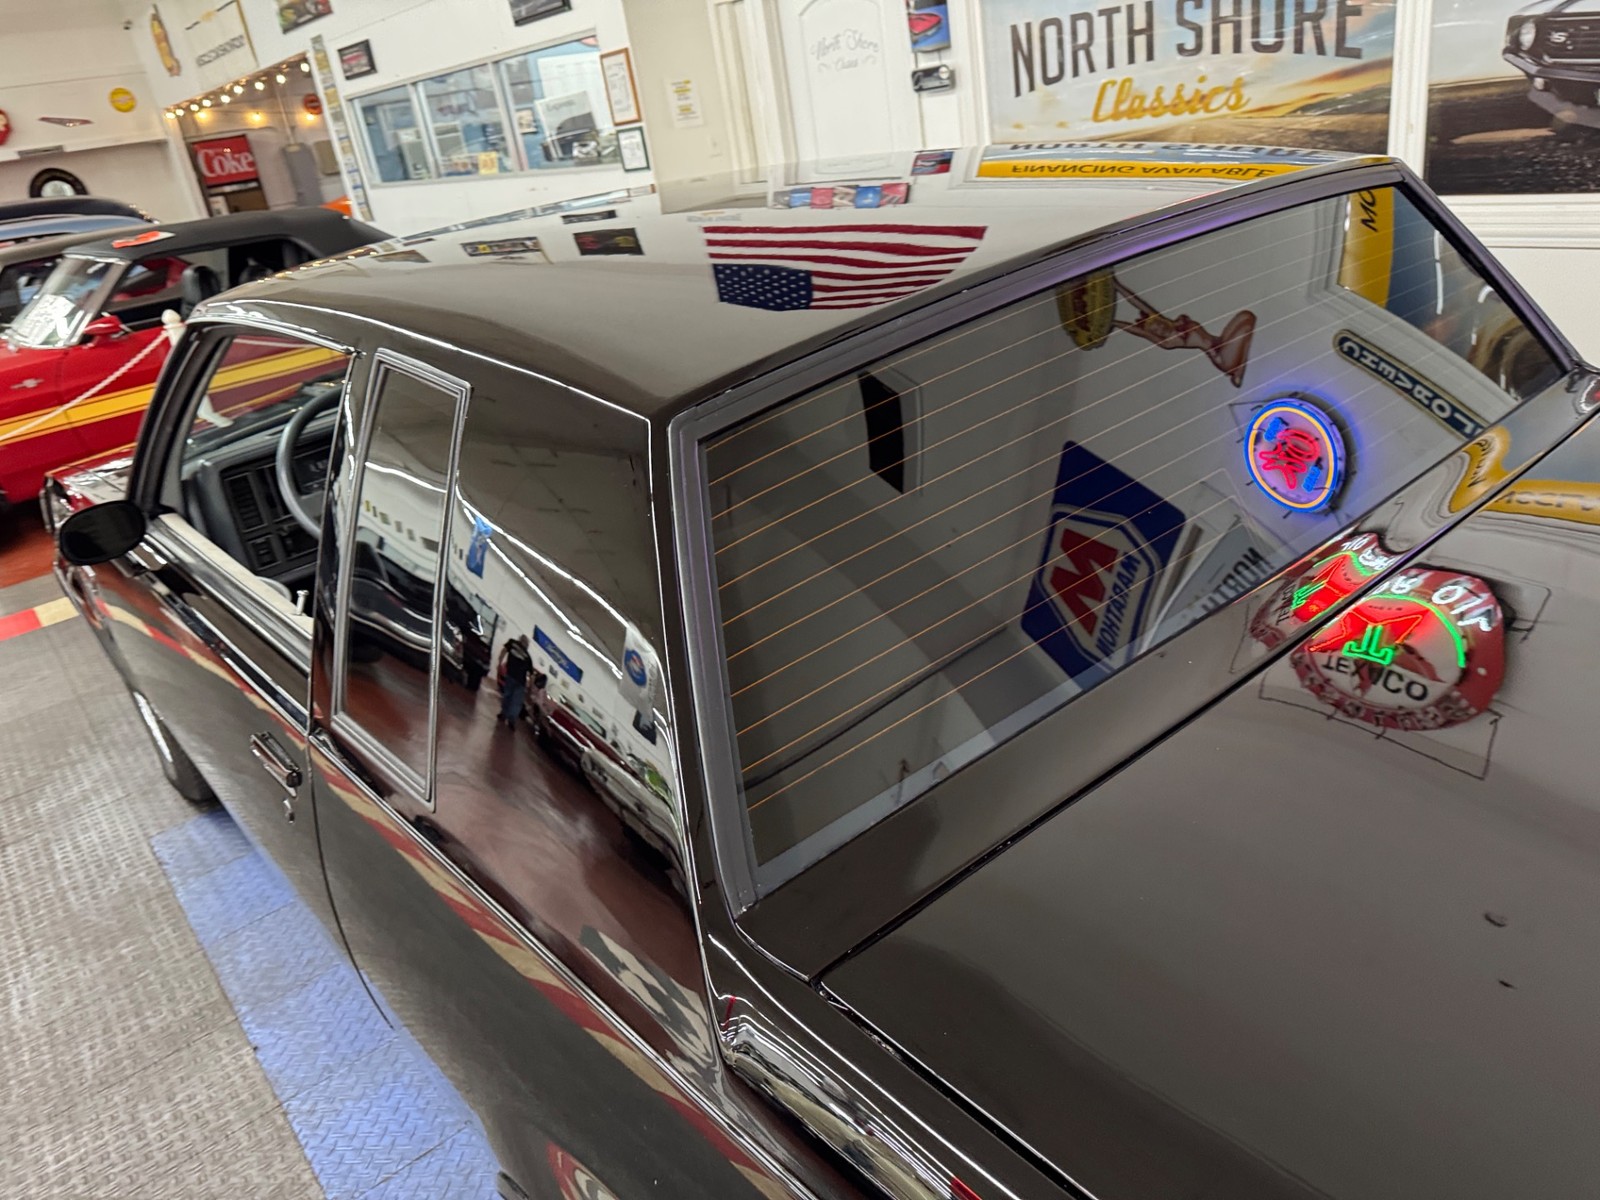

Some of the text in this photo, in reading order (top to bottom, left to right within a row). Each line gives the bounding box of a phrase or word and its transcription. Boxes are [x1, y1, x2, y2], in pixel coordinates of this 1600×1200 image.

[1009, 0, 1363, 97] NORTH SHORE
[1092, 75, 1251, 122] Classics
[197, 147, 256, 177] Coke
